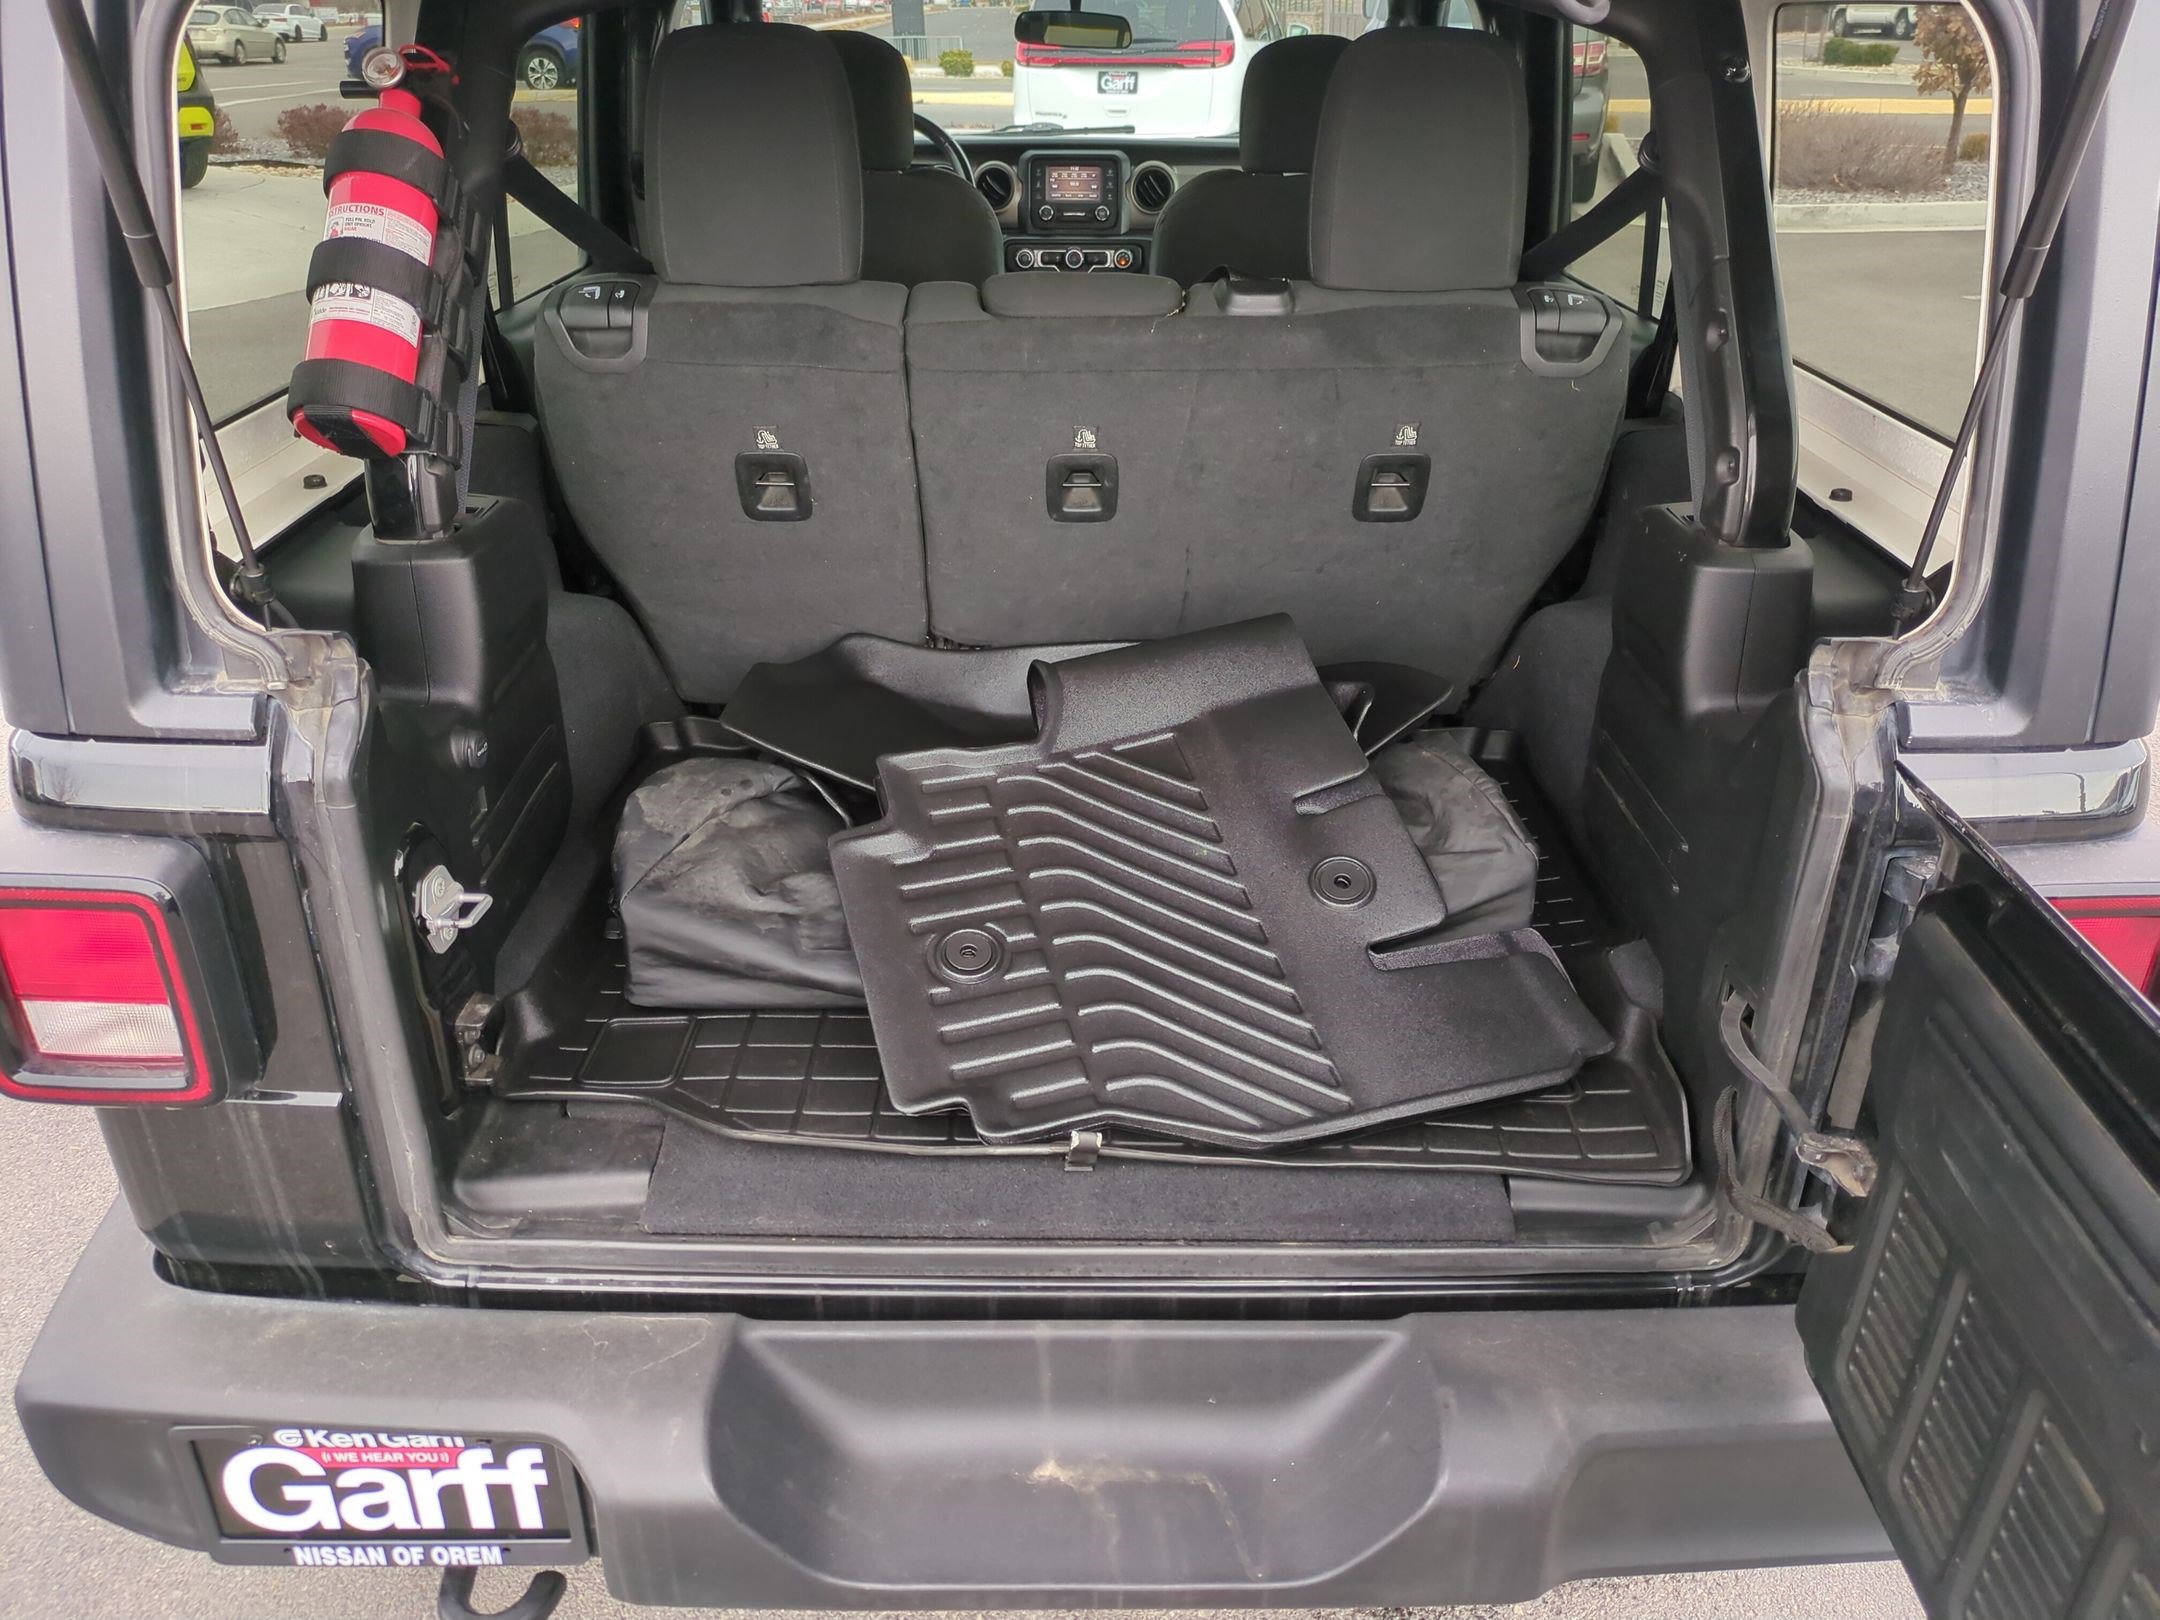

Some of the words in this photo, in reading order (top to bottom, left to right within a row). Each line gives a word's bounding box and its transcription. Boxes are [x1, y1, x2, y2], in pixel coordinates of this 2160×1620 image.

[333, 1452, 359, 1463] WE
[362, 1452, 404, 1463] HEAR
[404, 1452, 438, 1463] YOU
[221, 1447, 549, 1532] Garff
[293, 1546, 388, 1566] NISSAN
[391, 1546, 424, 1566] OF
[430, 1546, 503, 1566] OREM
